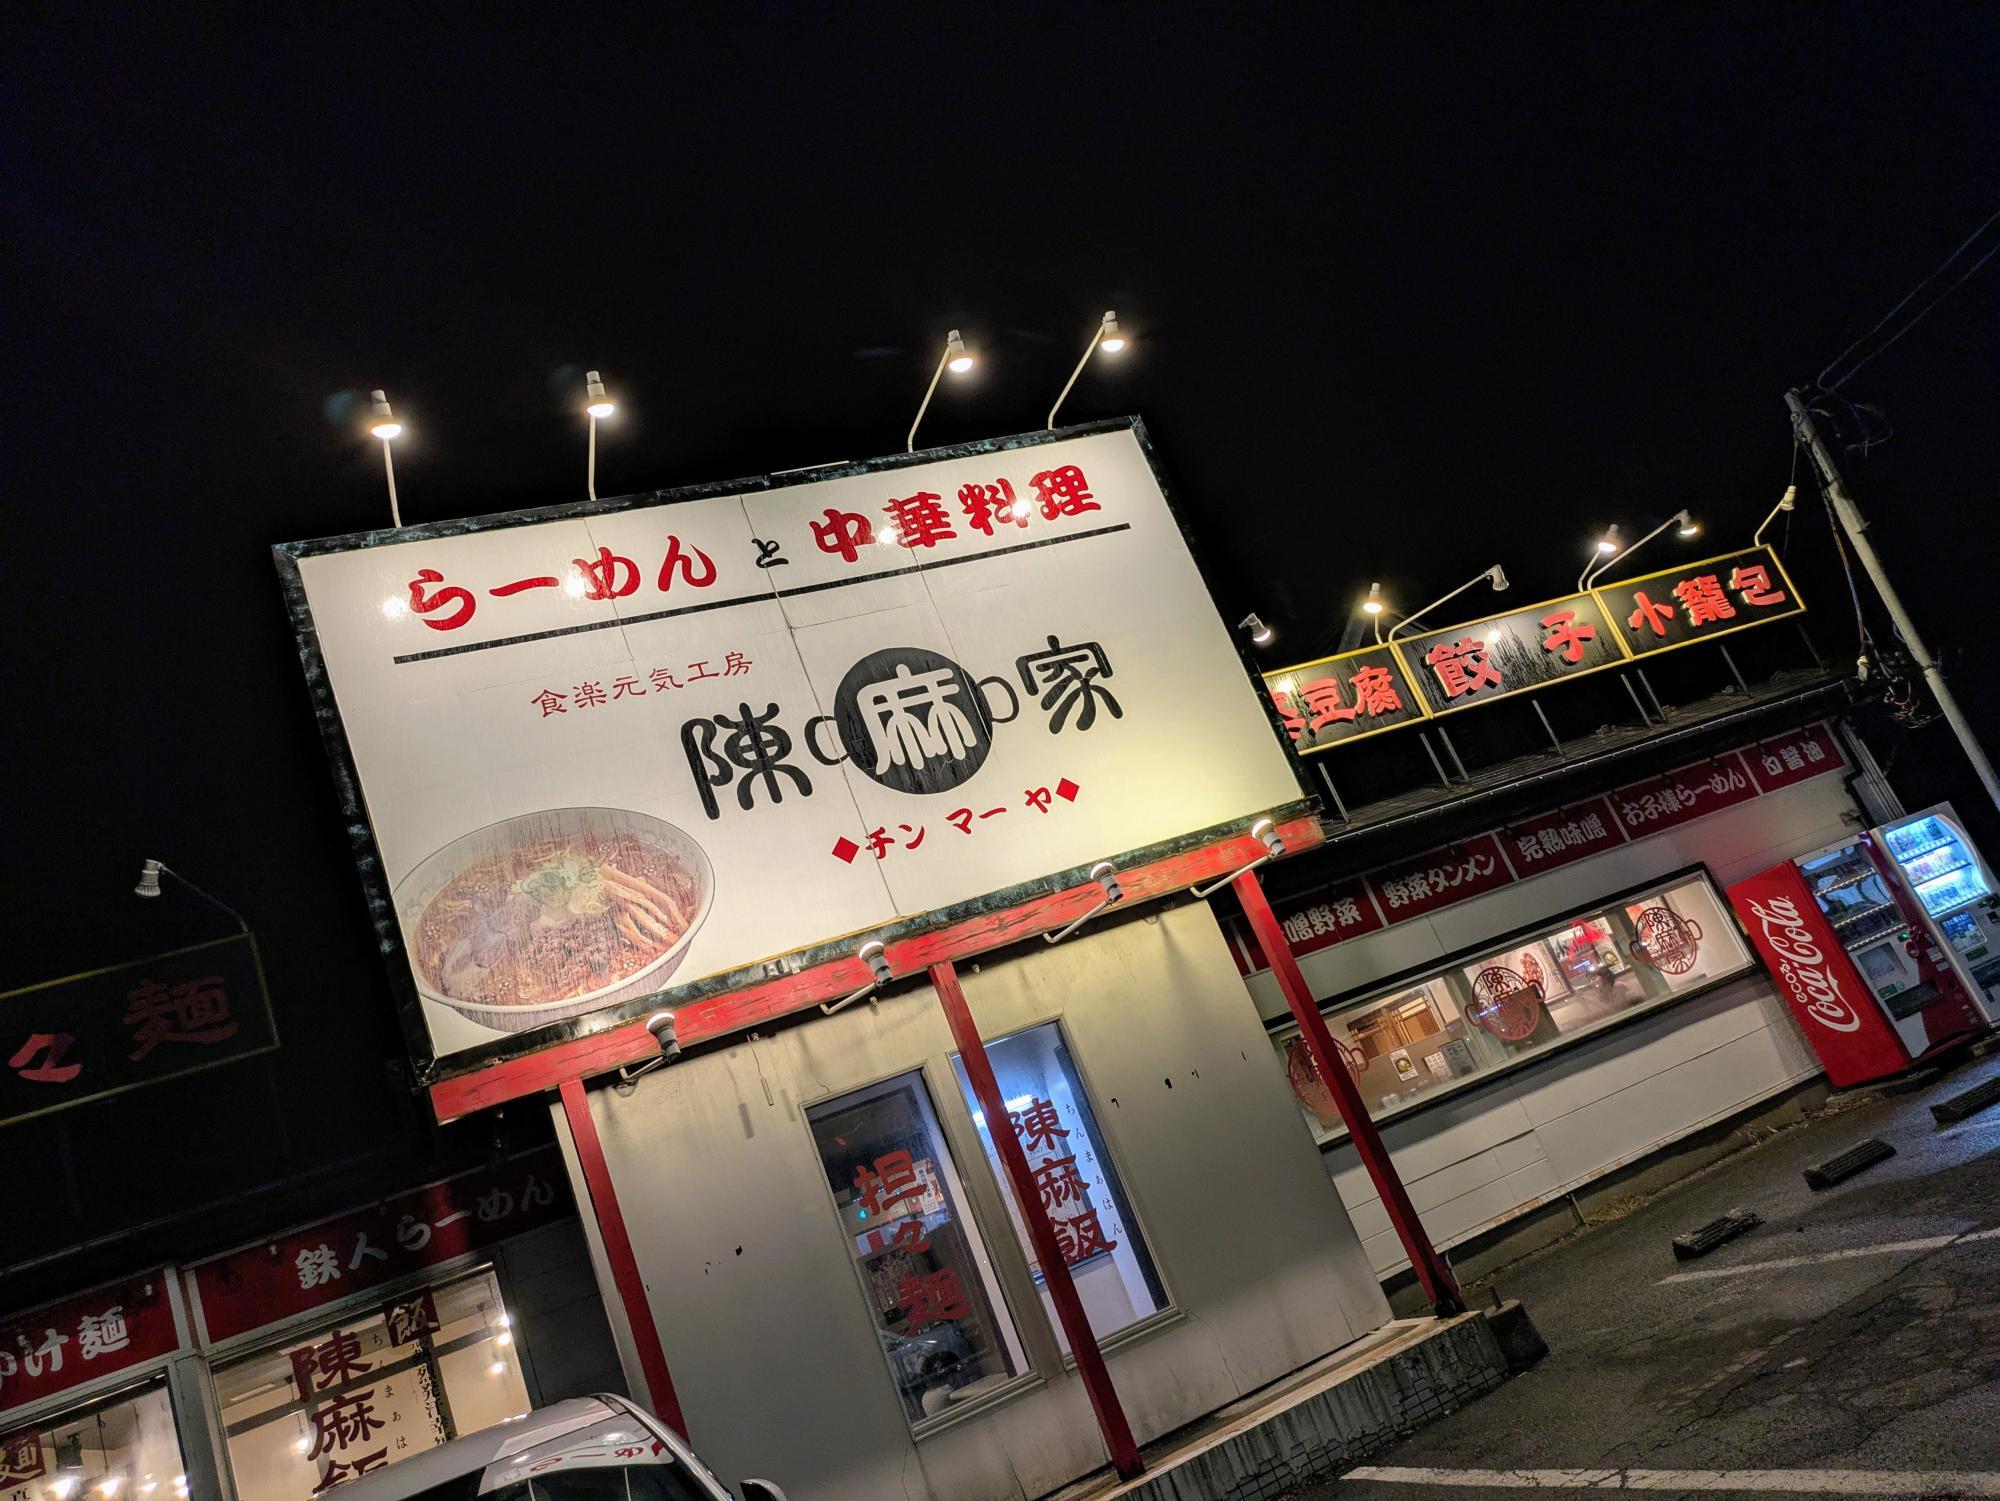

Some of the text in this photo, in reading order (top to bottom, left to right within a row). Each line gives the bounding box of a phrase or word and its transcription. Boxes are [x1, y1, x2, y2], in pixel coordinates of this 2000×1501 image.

[409, 464, 1102, 632] らーめん と 中華料理
[1629, 564, 1785, 637] 小籠包
[531, 651, 754, 719] 食楽元気工房
[1426, 609, 1596, 698] 餃子
[680, 635, 1123, 820] 陳麻家
[1760, 740, 1827, 776] 白醤油
[1517, 812, 1608, 862] 完熟味噌
[1621, 767, 1748, 826] お子様らーめん
[1281, 897, 1363, 945] 噌野菜
[1382, 854, 1495, 909] 野菜タンメン
[1746, 895, 1860, 1032] Coca-Cola
[1006, 1097, 1118, 1267] 陳麻飯
[294, 1173, 553, 1290] 鉄人らーめん
[853, 1148, 971, 1338] 担々麺
